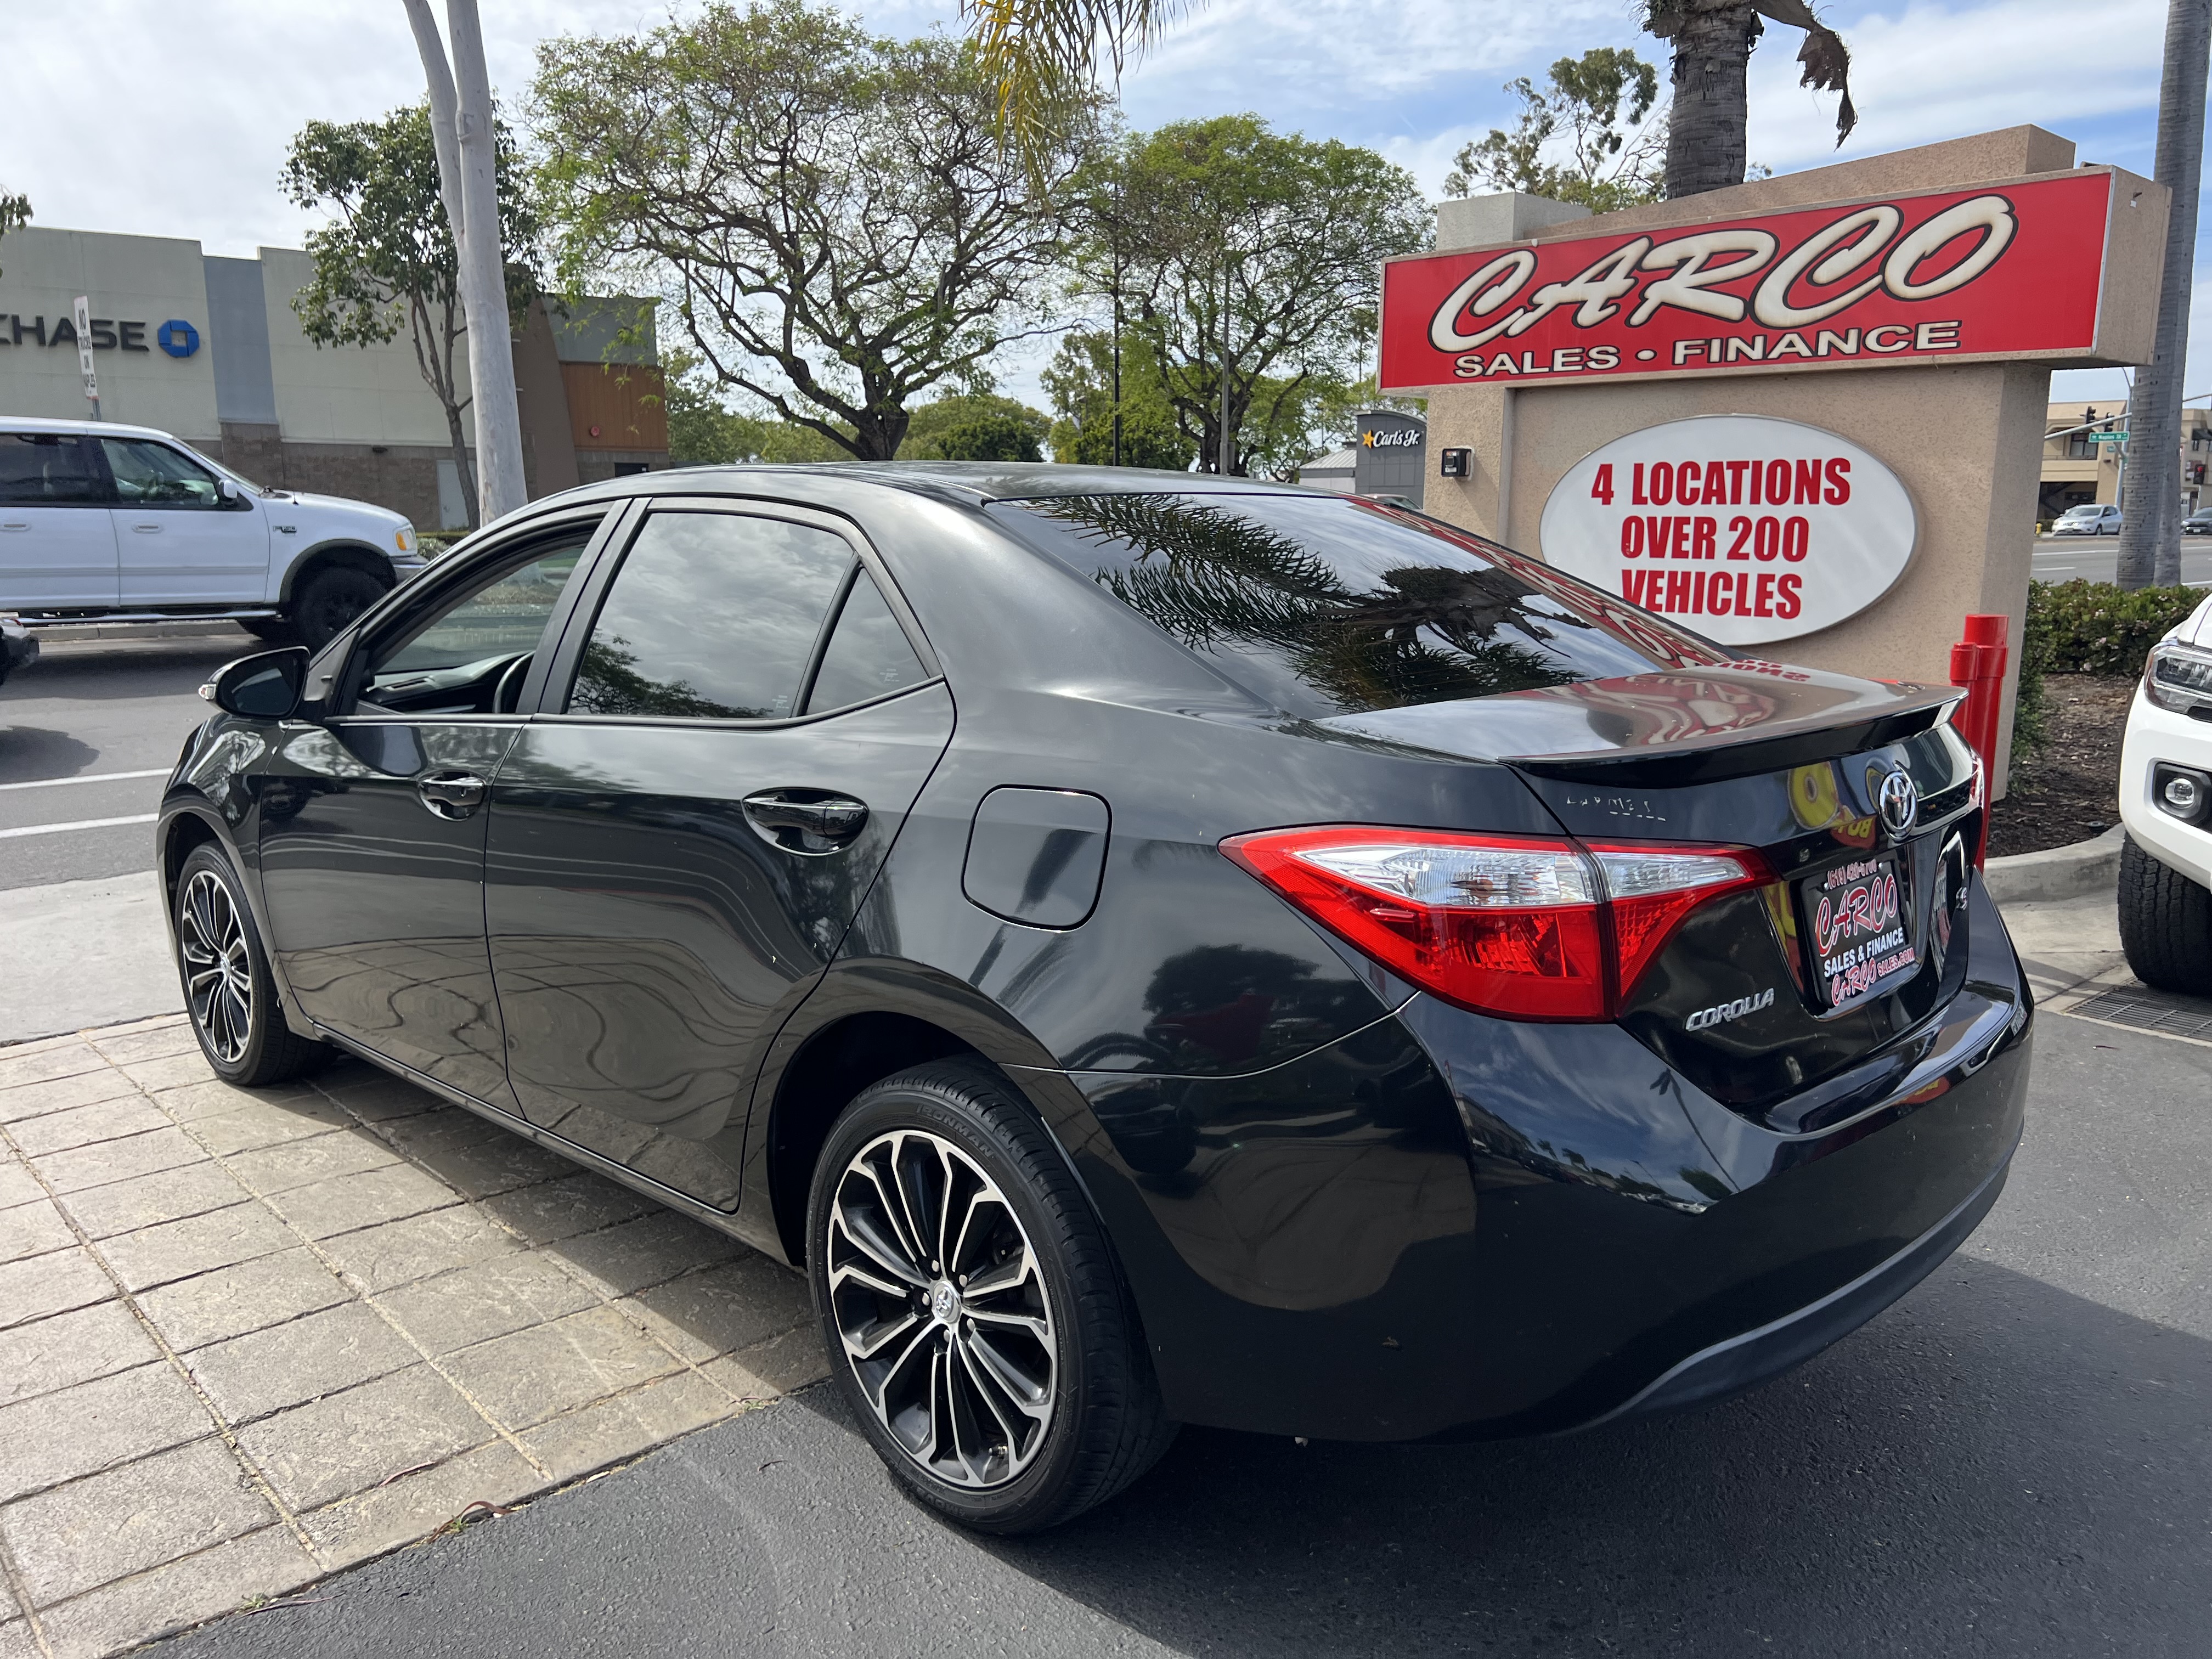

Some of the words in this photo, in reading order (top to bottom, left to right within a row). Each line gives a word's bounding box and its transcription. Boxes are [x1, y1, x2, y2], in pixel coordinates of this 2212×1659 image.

[1427, 194, 2019, 354] CARCO
[1454, 344, 1622, 379] SALES
[1672, 320, 1962, 366] FINANCE
[1373, 430, 1403, 448] Carl's
[1403, 429, 1420, 447] Jr.
[1590, 463, 1615, 505] 4
[1632, 458, 1851, 506] LOCATIONS
[1621, 515, 1717, 560] OVER
[1726, 515, 1810, 562] 200
[1621, 569, 1802, 619] VEHICLES
[1815, 873, 1898, 957] CARCO
[1824, 948, 1855, 978] SALES
[1858, 945, 1865, 962] &
[1866, 927, 1904, 958] FINANCE
[1831, 957, 1877, 1007] CARCO
[1877, 947, 1915, 977] SALES.COM
[1685, 988, 1774, 1032] COROLLA
[916, 1103, 995, 1159] IRONMAN
